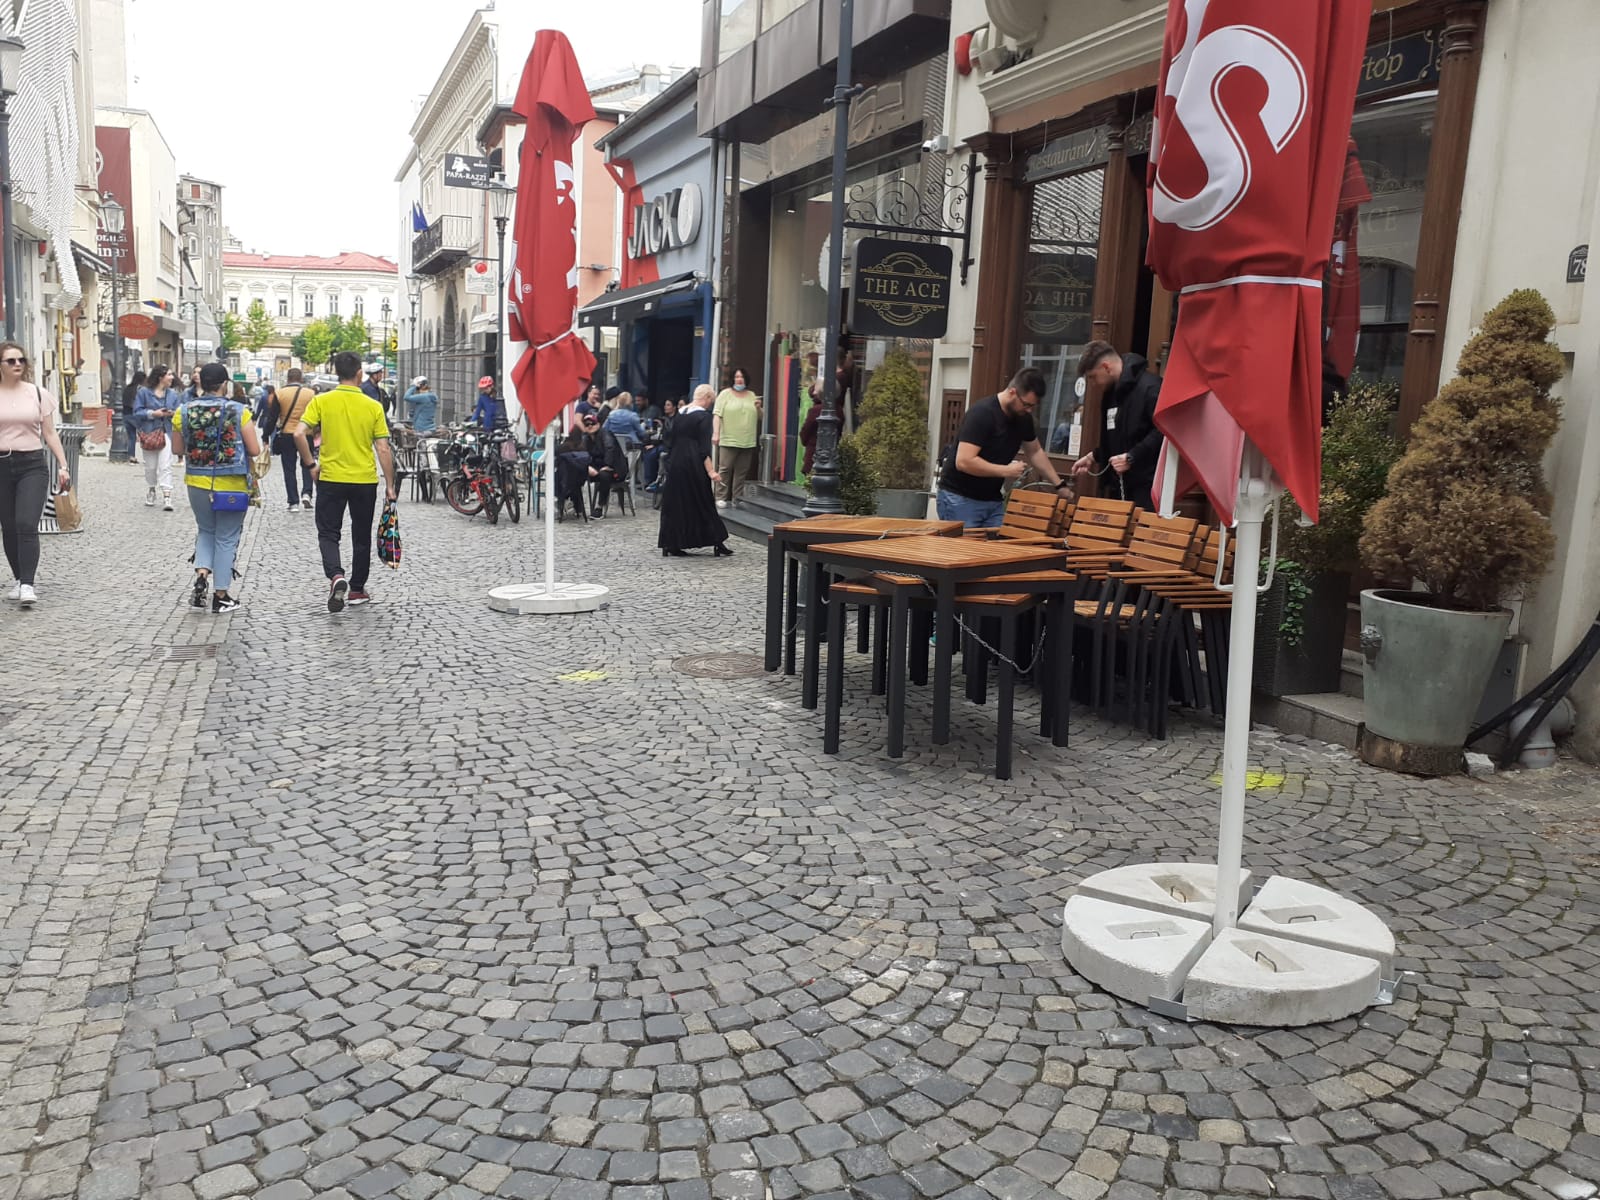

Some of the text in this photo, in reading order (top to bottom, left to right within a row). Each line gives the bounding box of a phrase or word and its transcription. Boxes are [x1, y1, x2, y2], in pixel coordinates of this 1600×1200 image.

[1029, 141, 1091, 172] Restaurant
[446, 170, 487, 181] PAPA-RAZZI
[864, 277, 941, 299] THE ACE
